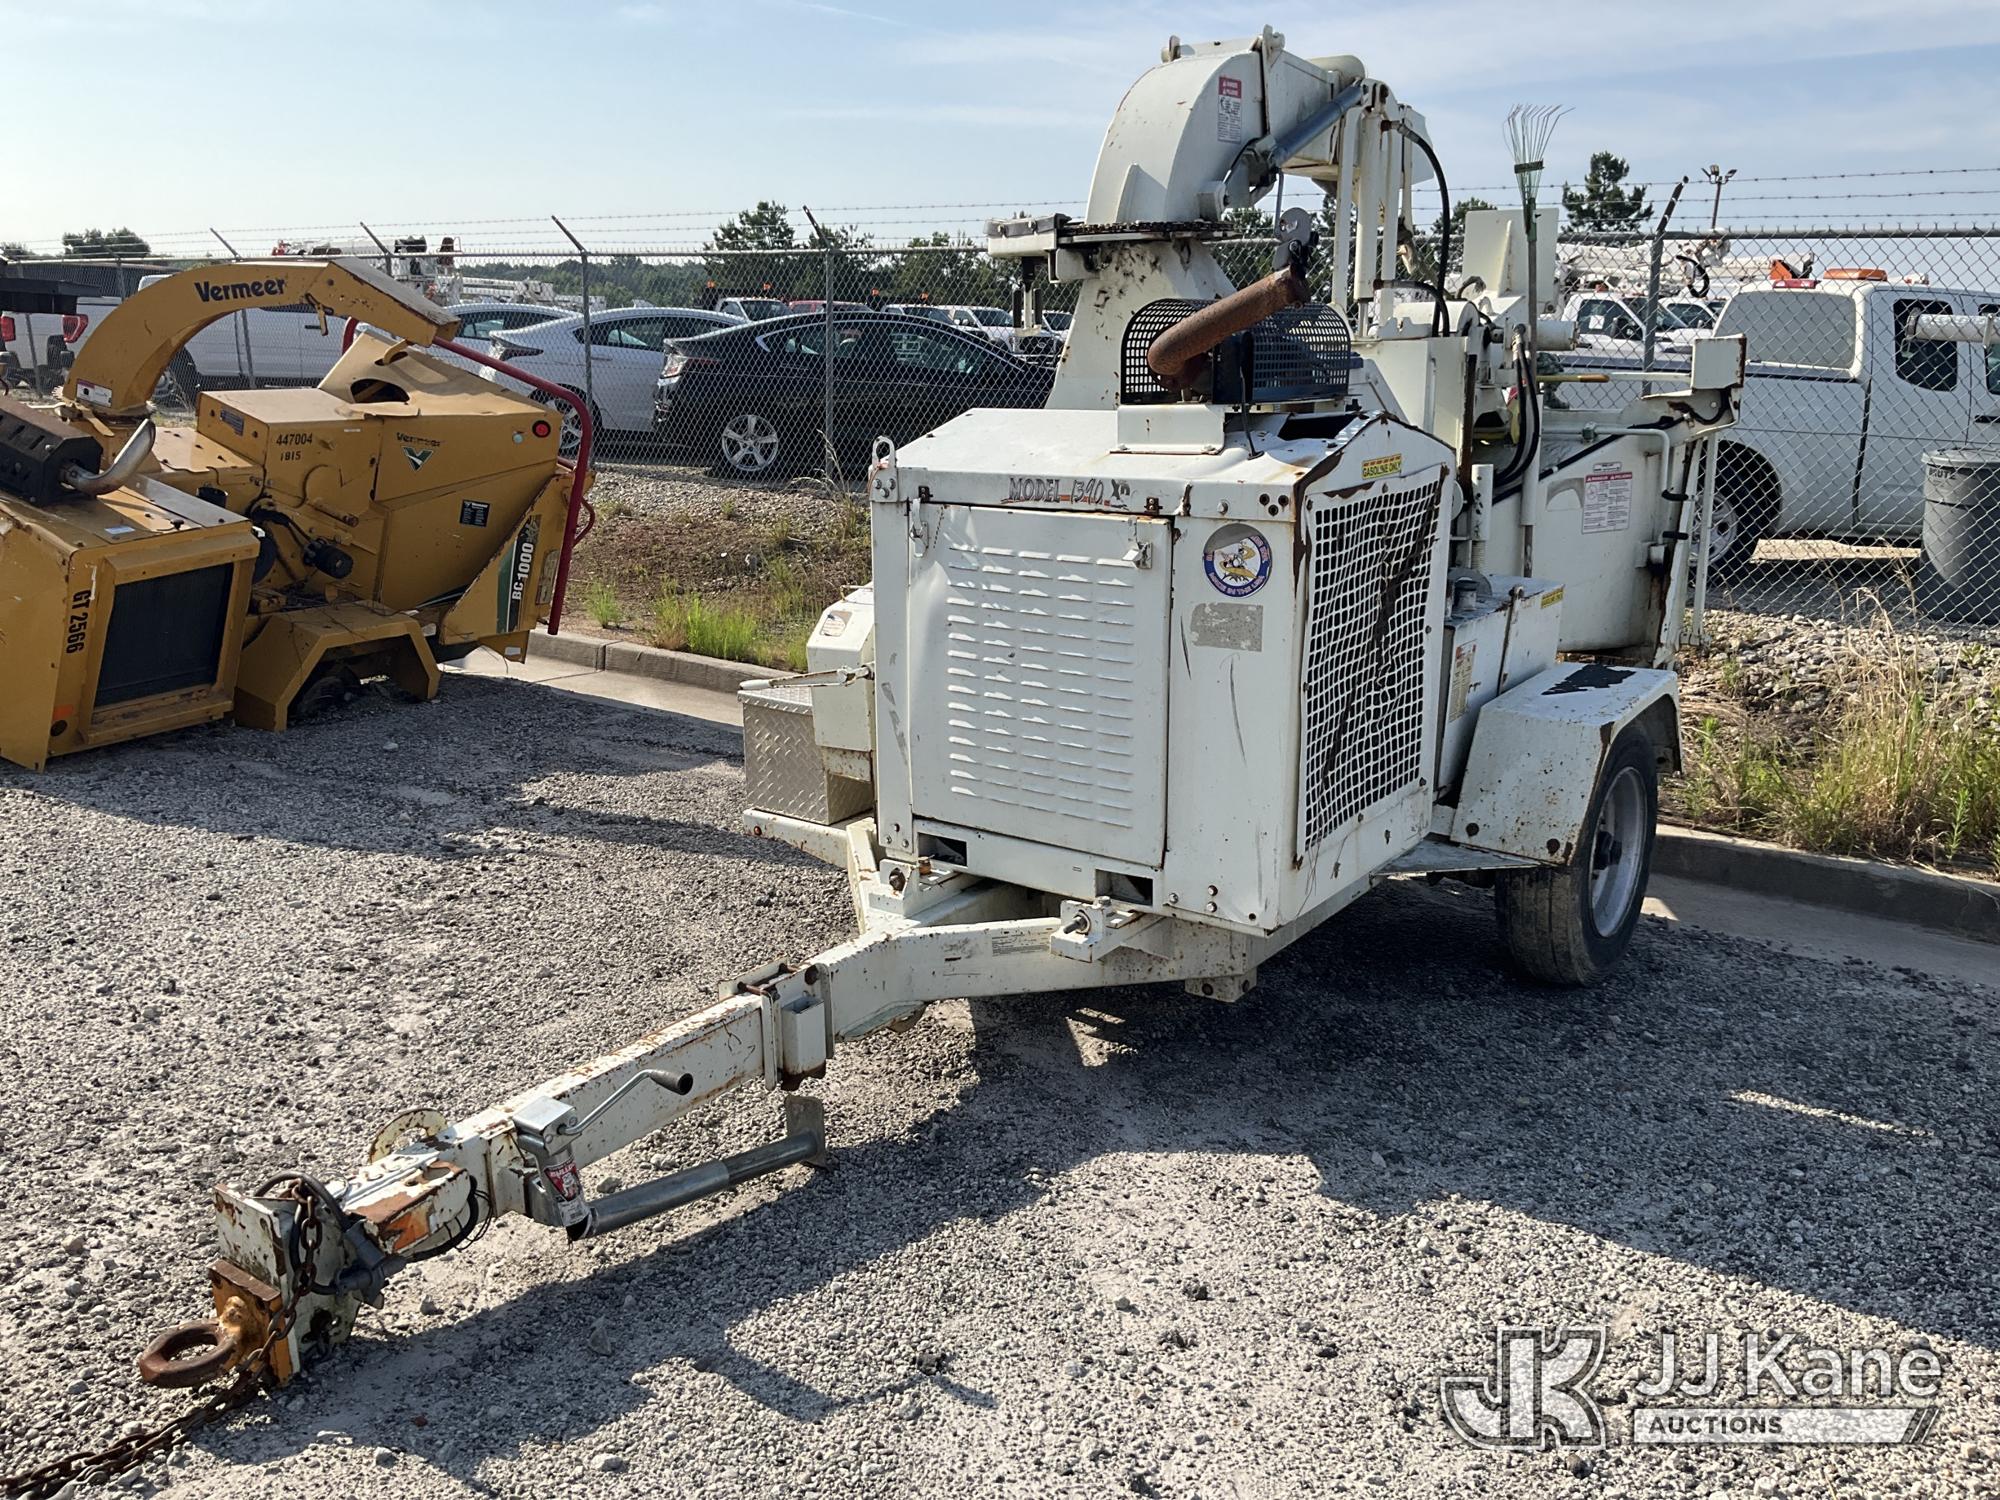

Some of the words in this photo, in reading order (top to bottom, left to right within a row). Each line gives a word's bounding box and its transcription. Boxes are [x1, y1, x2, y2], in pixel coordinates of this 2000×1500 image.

[194, 279, 285, 302] Vermeer
[276, 432, 313, 446] 447004
[1009, 478, 1060, 503] MODEL
[72, 589, 91, 610] GT
[65, 611, 89, 654] 2566
